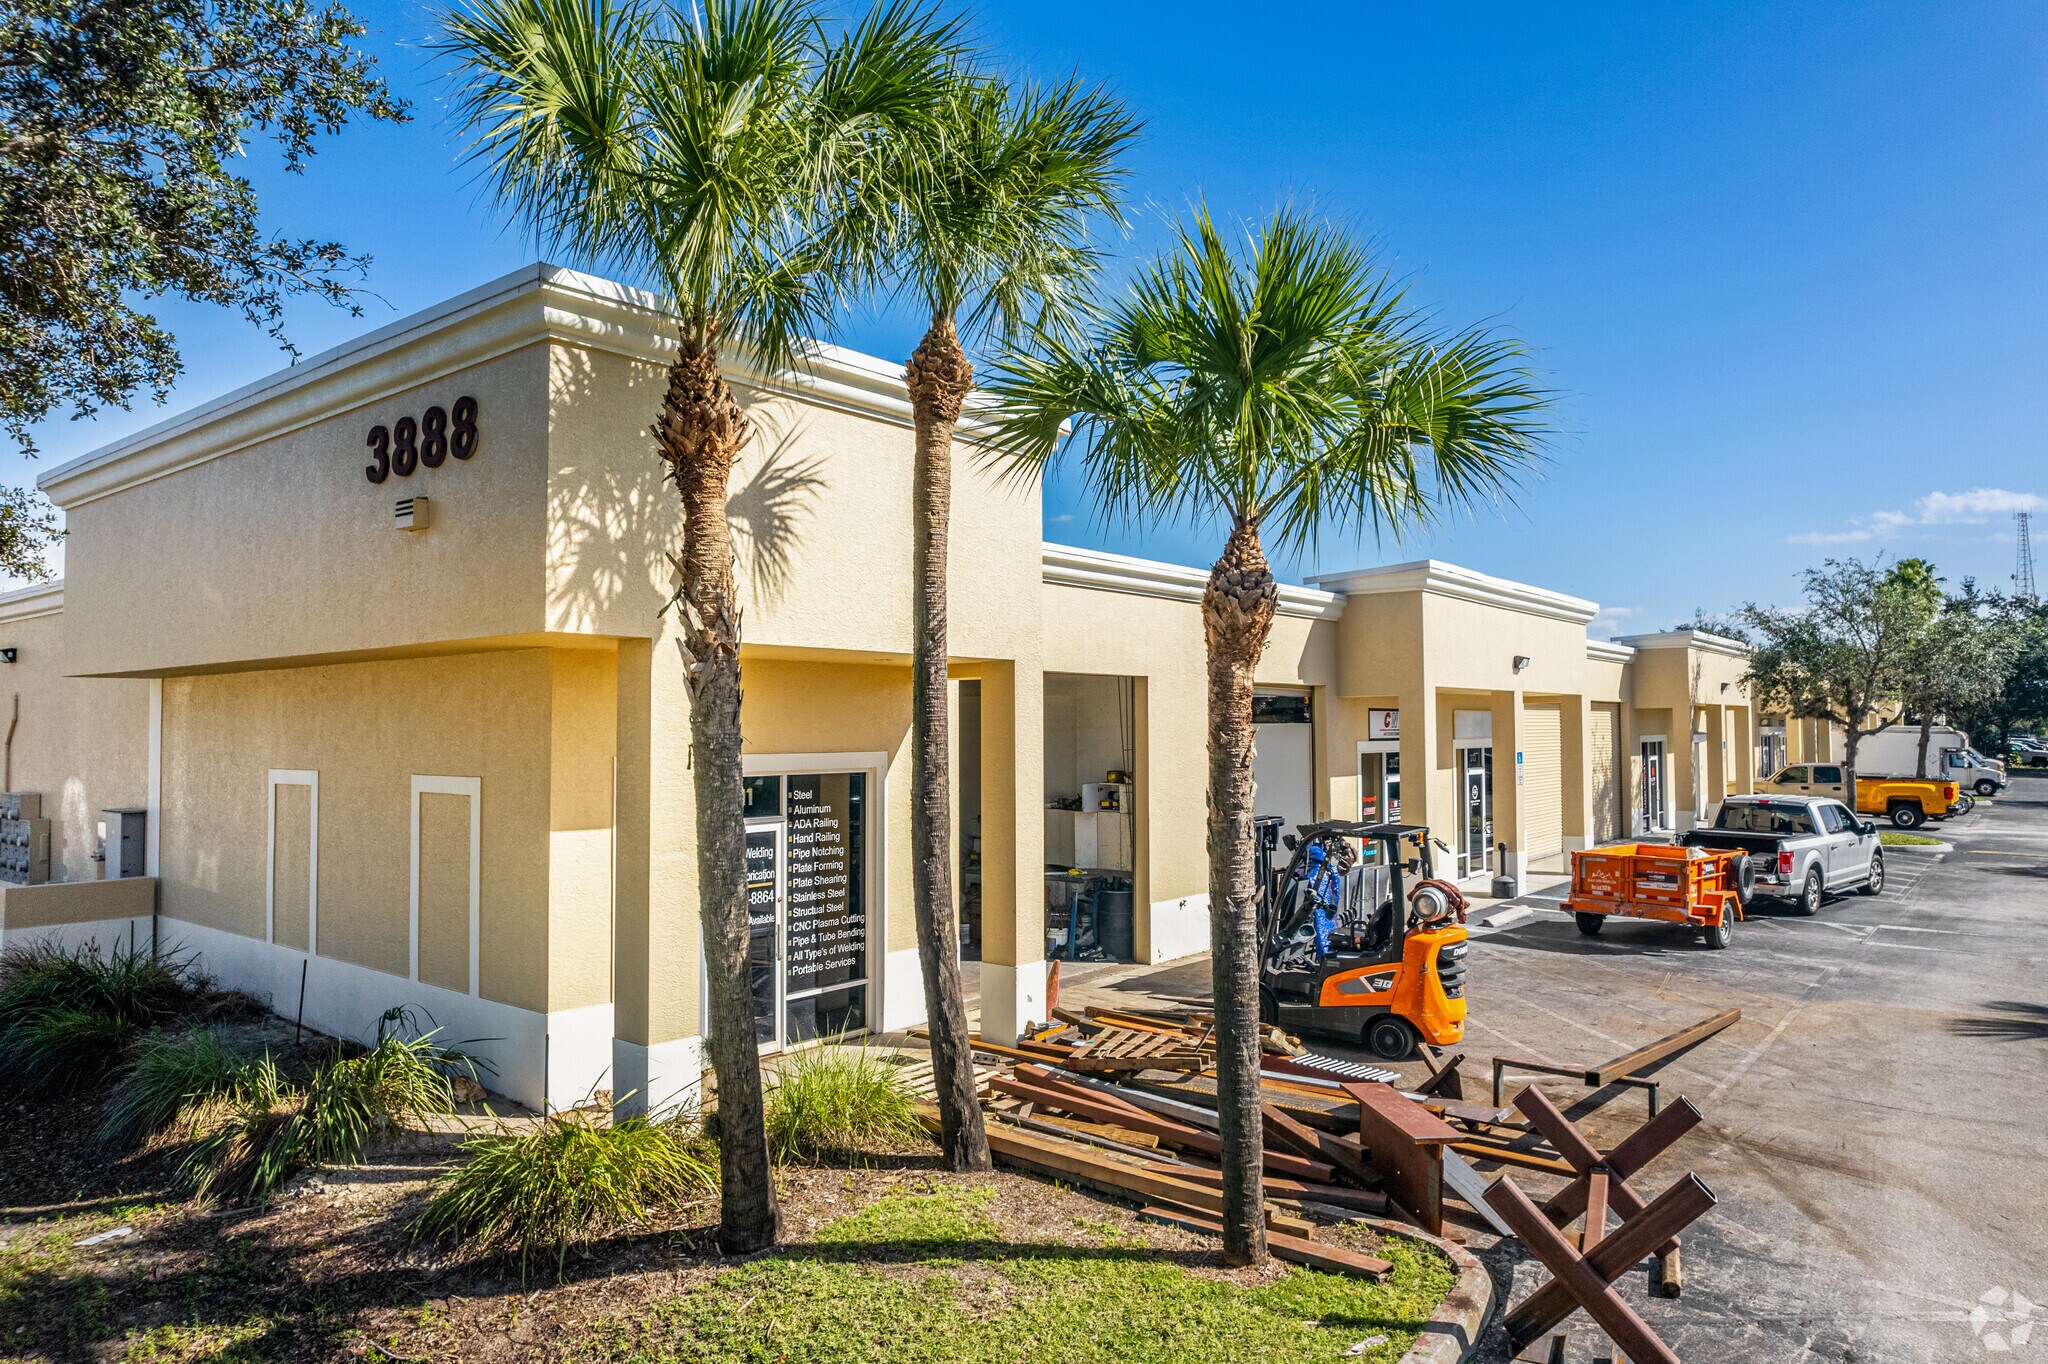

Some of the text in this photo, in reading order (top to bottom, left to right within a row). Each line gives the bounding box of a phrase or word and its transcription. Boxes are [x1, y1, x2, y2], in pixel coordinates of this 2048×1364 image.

[365, 396, 479, 484] 3888
[793, 790, 813, 800] Steel
[793, 804, 831, 815] Aluminum
[793, 818, 838, 829] ADA Railing
[792, 832, 840, 844] Hand Railing
[745, 846, 774, 860] Welding
[792, 846, 845, 860] Pipe Notching
[792, 860, 844, 873] Plate Forming
[792, 873, 847, 888] Plate Shearing
[792, 887, 846, 903] Stainless Steel
[792, 902, 844, 918] Structual Steel
[748, 913, 775, 926] Available
[792, 913, 865, 932] CNC Plasma Cutting
[792, 927, 865, 948] Pipe & Tube Bending
[792, 942, 865, 961] All Type's of Welding
[792, 957, 856, 976] Portable Services
